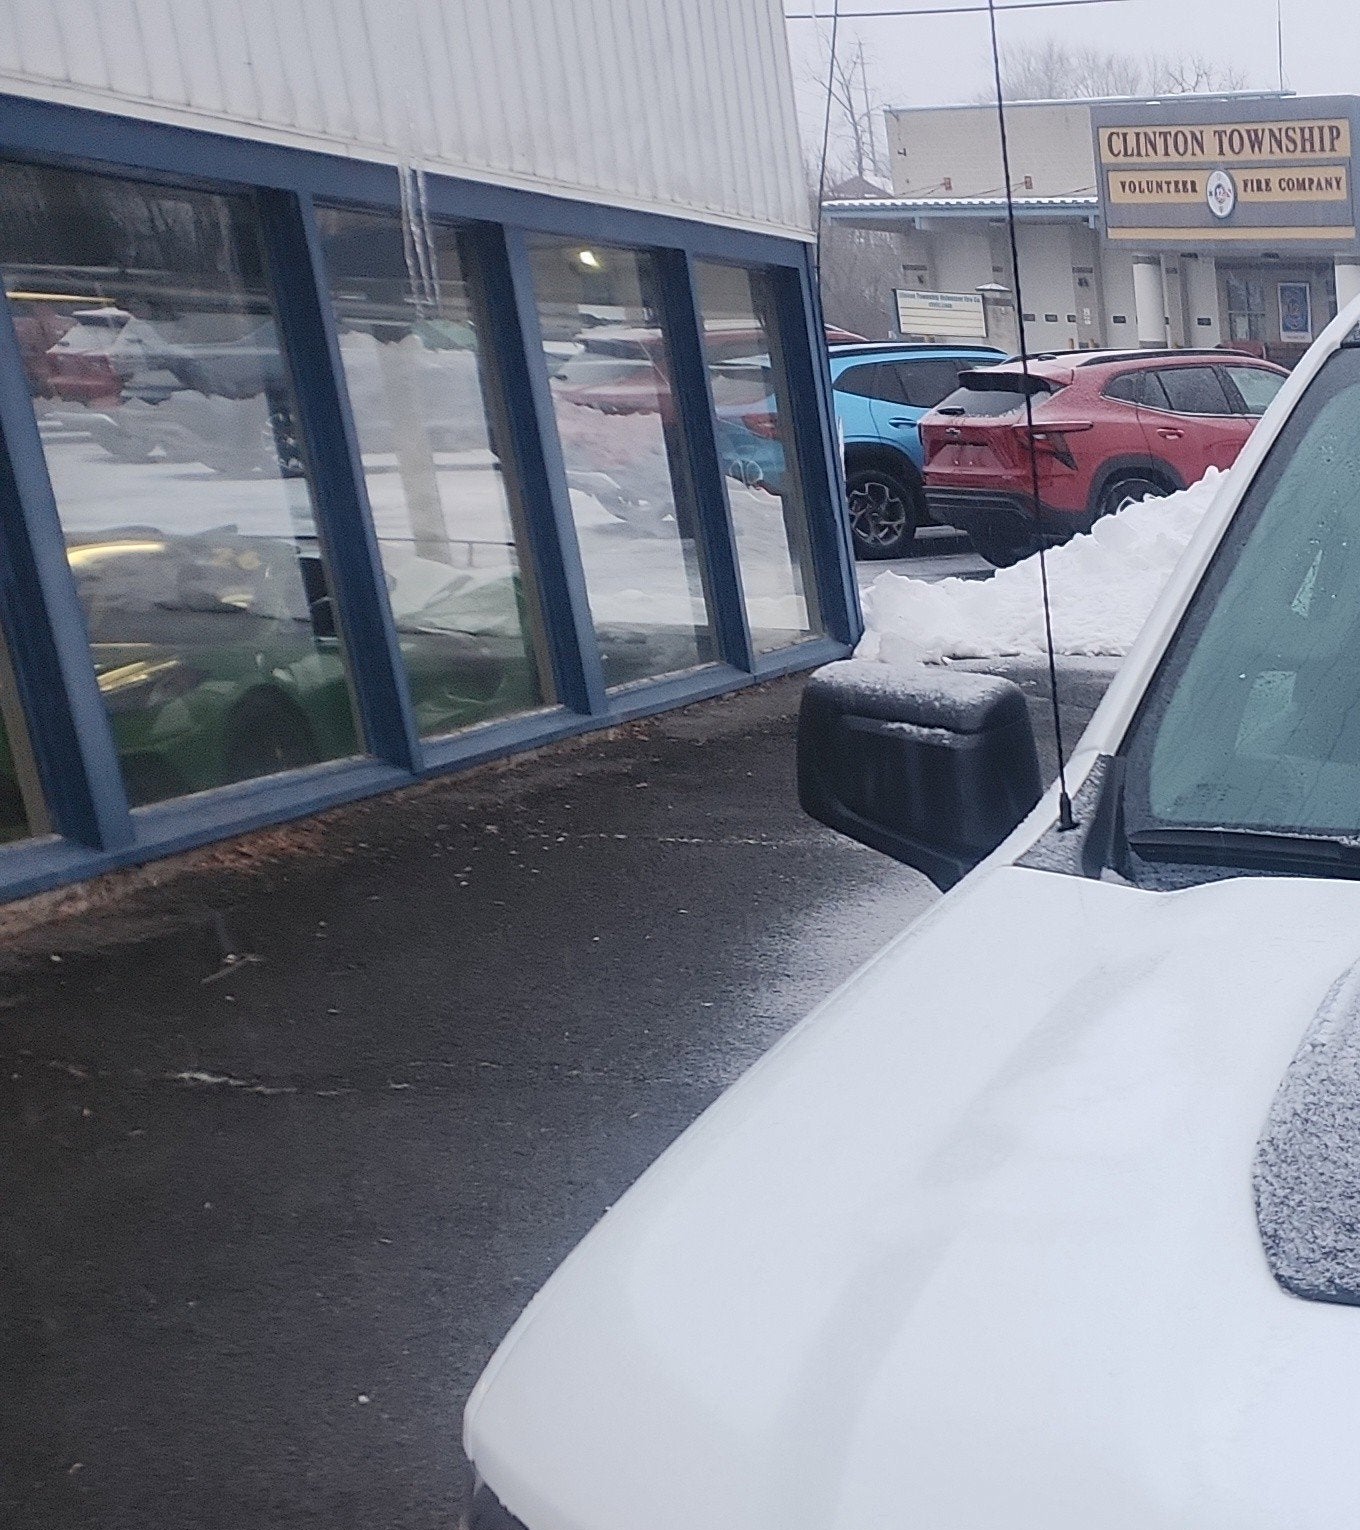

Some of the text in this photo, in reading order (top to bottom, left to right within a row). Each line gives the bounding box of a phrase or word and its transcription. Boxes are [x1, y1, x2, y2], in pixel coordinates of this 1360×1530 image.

[1107, 125, 1340, 158] CLINTON TOWNSHIP
[1120, 176, 1342, 194] VOLUNTEER FIRE COMPANY
